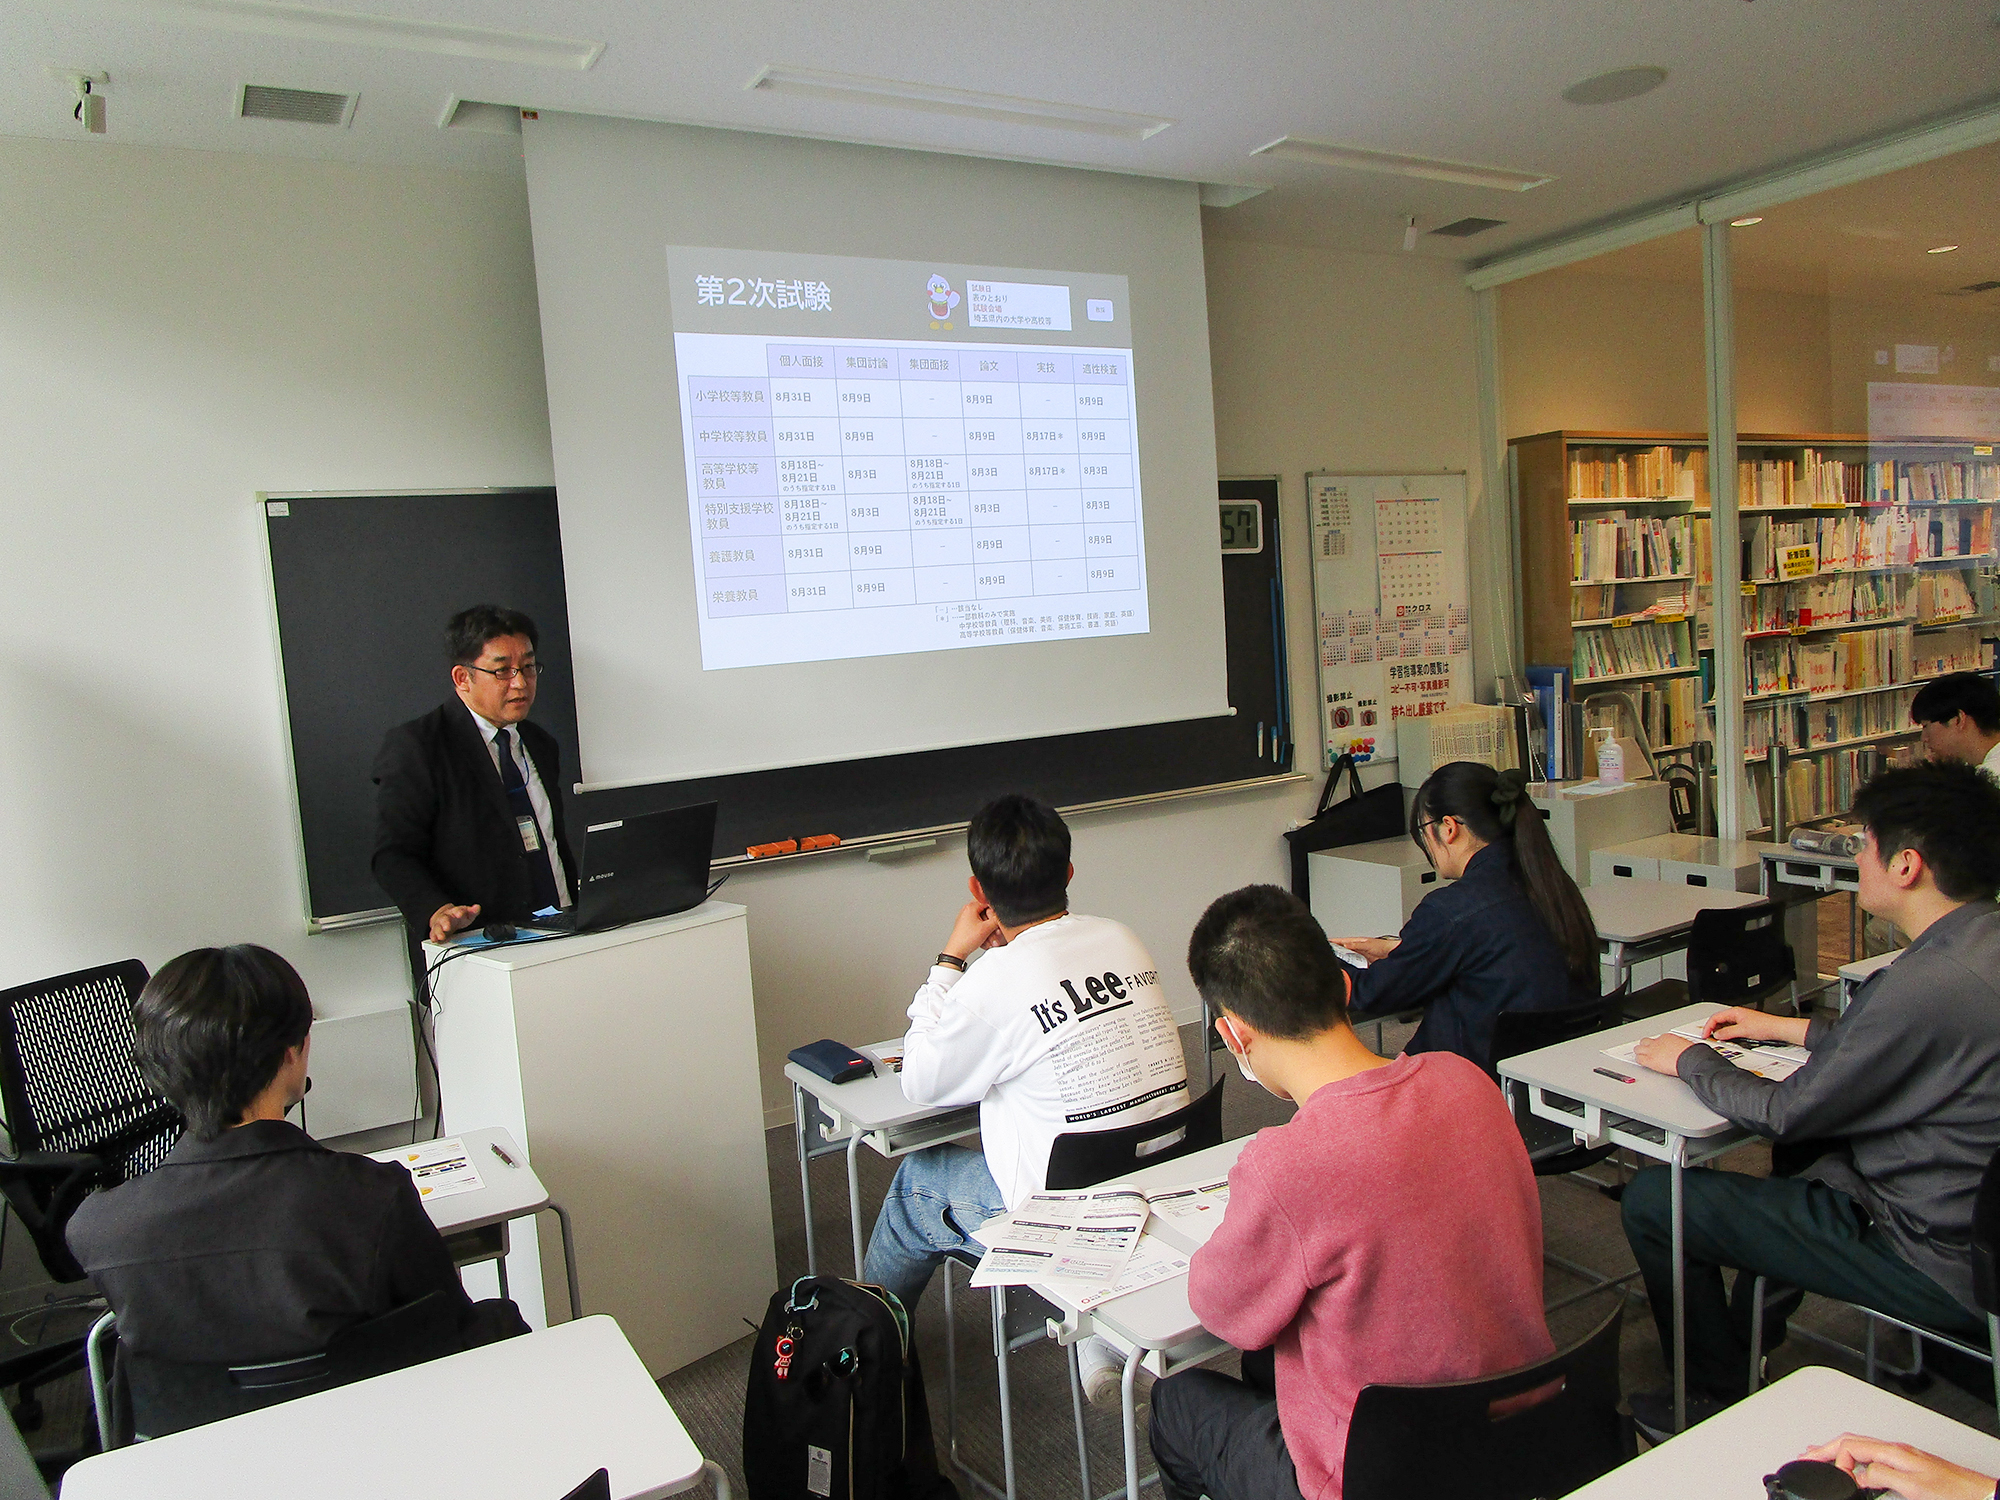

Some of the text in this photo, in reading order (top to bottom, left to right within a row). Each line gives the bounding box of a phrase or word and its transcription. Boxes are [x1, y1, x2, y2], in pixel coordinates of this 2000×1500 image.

[694, 274, 832, 312] 第2次試験
[780, 355, 824, 368] 個人面接
[846, 356, 888, 369] 集団討論
[910, 358, 950, 371] 集団面接
[980, 360, 998, 372] 論文
[1036, 362, 1056, 374] 実技
[1082, 364, 1118, 375] 適性検査
[696, 390, 764, 402] 小学校等教員
[776, 392, 811, 402] 8月31日
[842, 394, 871, 402] 8月9日
[966, 395, 992, 404] 8月9日
[1080, 397, 1104, 406] 8月9日
[700, 430, 768, 442] 中学校等教員
[778, 432, 814, 442] 8月31日
[845, 432, 874, 442] 8月9日
[969, 432, 996, 441] 8月9日
[1082, 432, 1106, 441] 8月9日
[702, 462, 758, 475] 高等学校等
[972, 468, 998, 477] 8月3日
[1084, 466, 1108, 476] 8月3日
[782, 473, 818, 482] 8月21日
[848, 470, 876, 480] 8月3日
[911, 471, 944, 480] 8月21日
[704, 478, 726, 490] 教員
[705, 502, 774, 516] 特別支援学校
[974, 504, 1000, 513] 8月3日
[1086, 501, 1110, 510] 8月3日
[785, 512, 820, 522] 8月21日
[851, 508, 880, 518] 8月3日
[914, 508, 946, 518] 8月21日
[706, 518, 730, 530] 教員
[1222, 511, 1250, 544] 57
[976, 540, 1003, 550] 8月9日
[1088, 536, 1112, 544] 8月9日
[788, 548, 824, 558] 8月31日
[854, 546, 882, 555] 8月9日
[709, 550, 756, 564] 養護教員
[1090, 570, 1115, 578] 8月9日
[979, 576, 1006, 585] 8月9日
[791, 586, 826, 597] 8月31日
[856, 583, 886, 593] 8月9日
[712, 589, 758, 603] 栄養教員
[1390, 662, 1450, 680] 学習指導案の閲覧は
[1326, 691, 1353, 704] 撮影禁止
[595, 872, 614, 880] mouse
[1030, 998, 1068, 1034] It's
[1060, 972, 1127, 1015] Lee
[1069, 1112, 1096, 1121] WORLD'S
[1100, 1103, 1126, 1115] LARGEST
